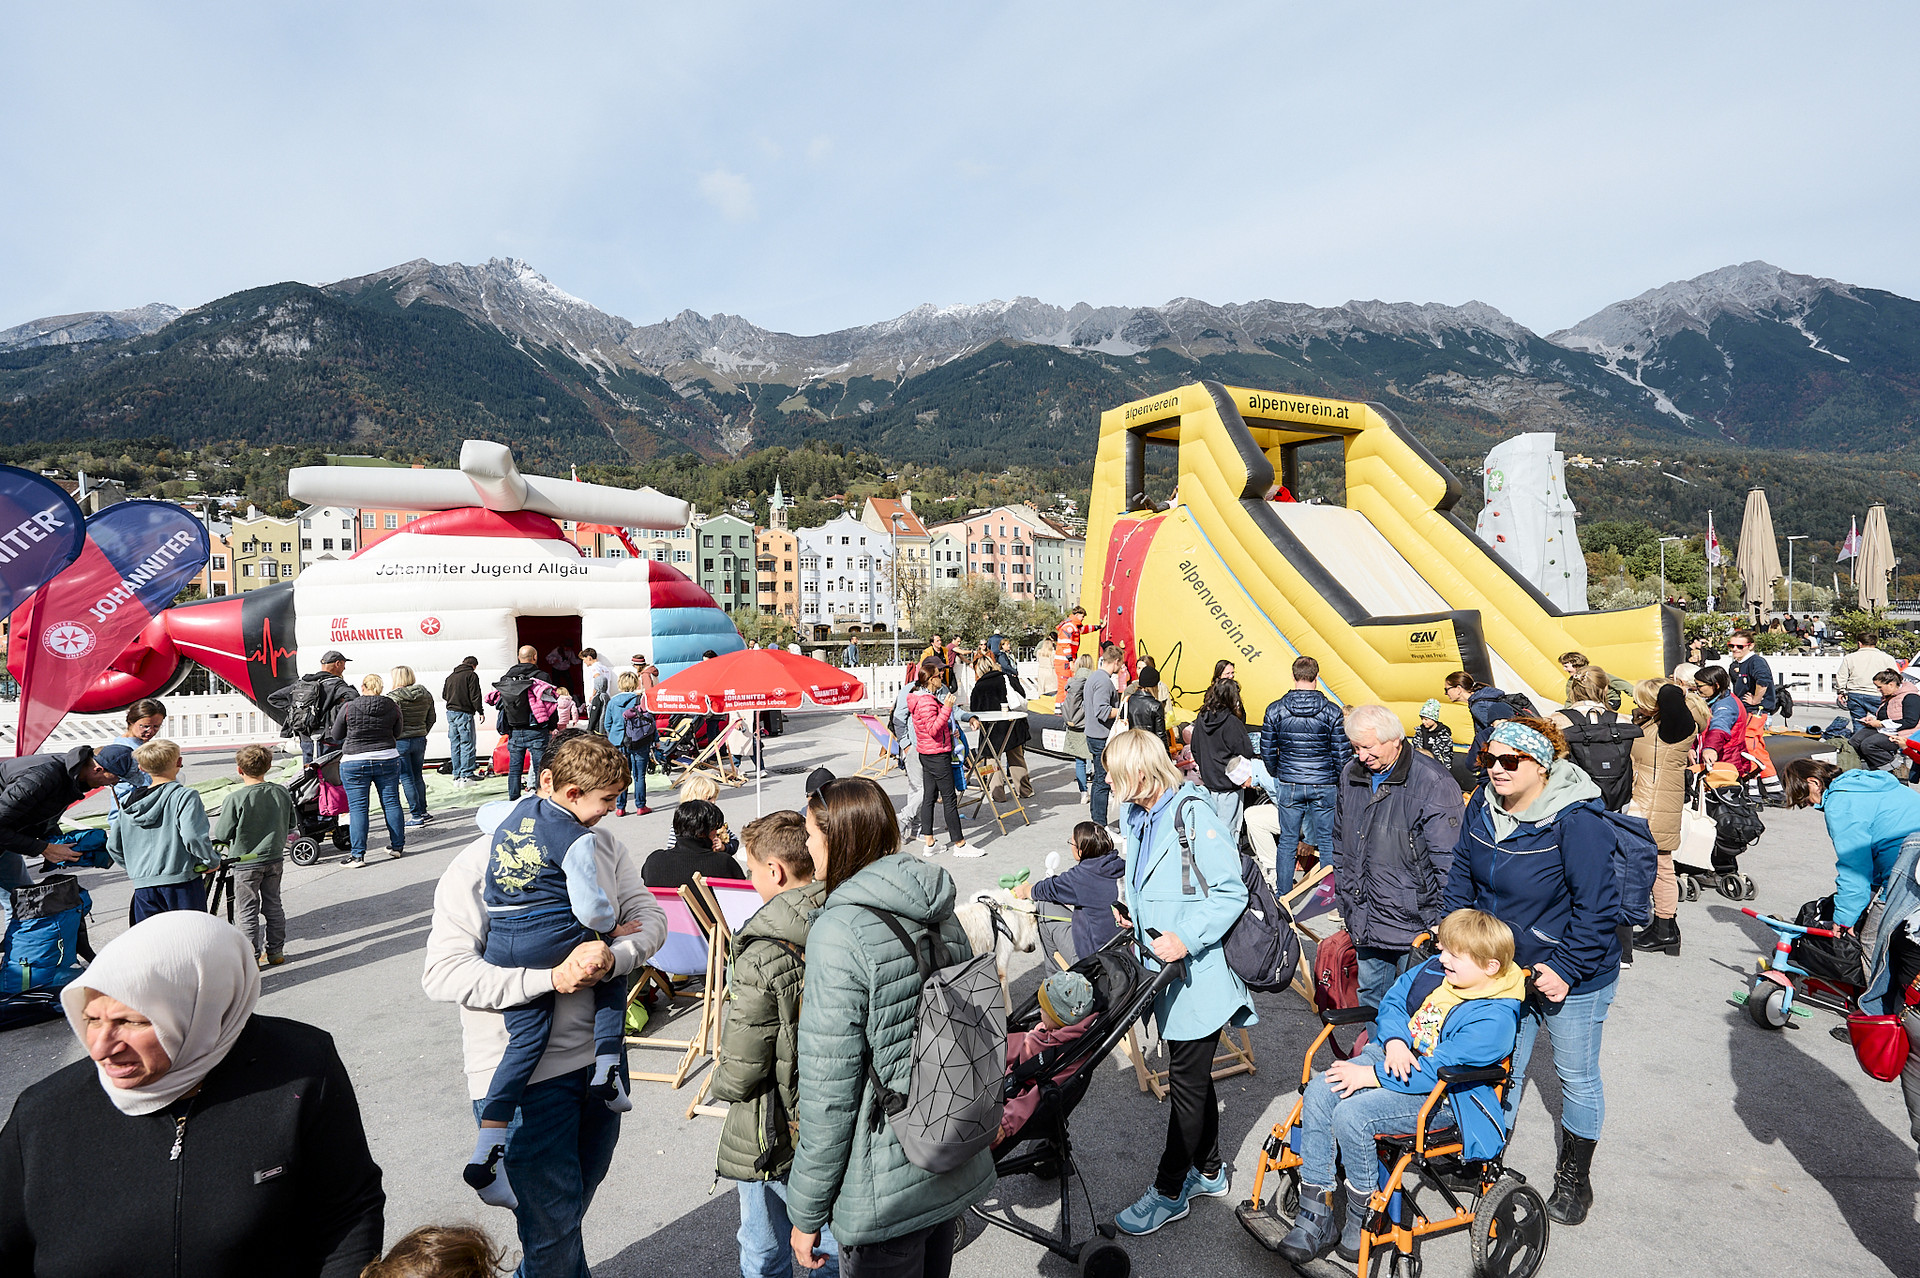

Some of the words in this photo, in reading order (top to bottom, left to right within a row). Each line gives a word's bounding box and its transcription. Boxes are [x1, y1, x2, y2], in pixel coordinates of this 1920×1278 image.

[1125, 395, 1178, 420] alpenverein
[1249, 394, 1349, 419] alpenverein.at
[88, 530, 196, 623] JOHANNITER
[376, 563, 466, 576] Johanniter
[471, 563, 532, 577] Jugend
[538, 563, 588, 577] Allgäu
[1179, 560, 1262, 662] alpenverein.at
[331, 617, 349, 629] DIE
[330, 627, 404, 642] JOHANNITER
[724, 694, 766, 702] JOHANNITER
